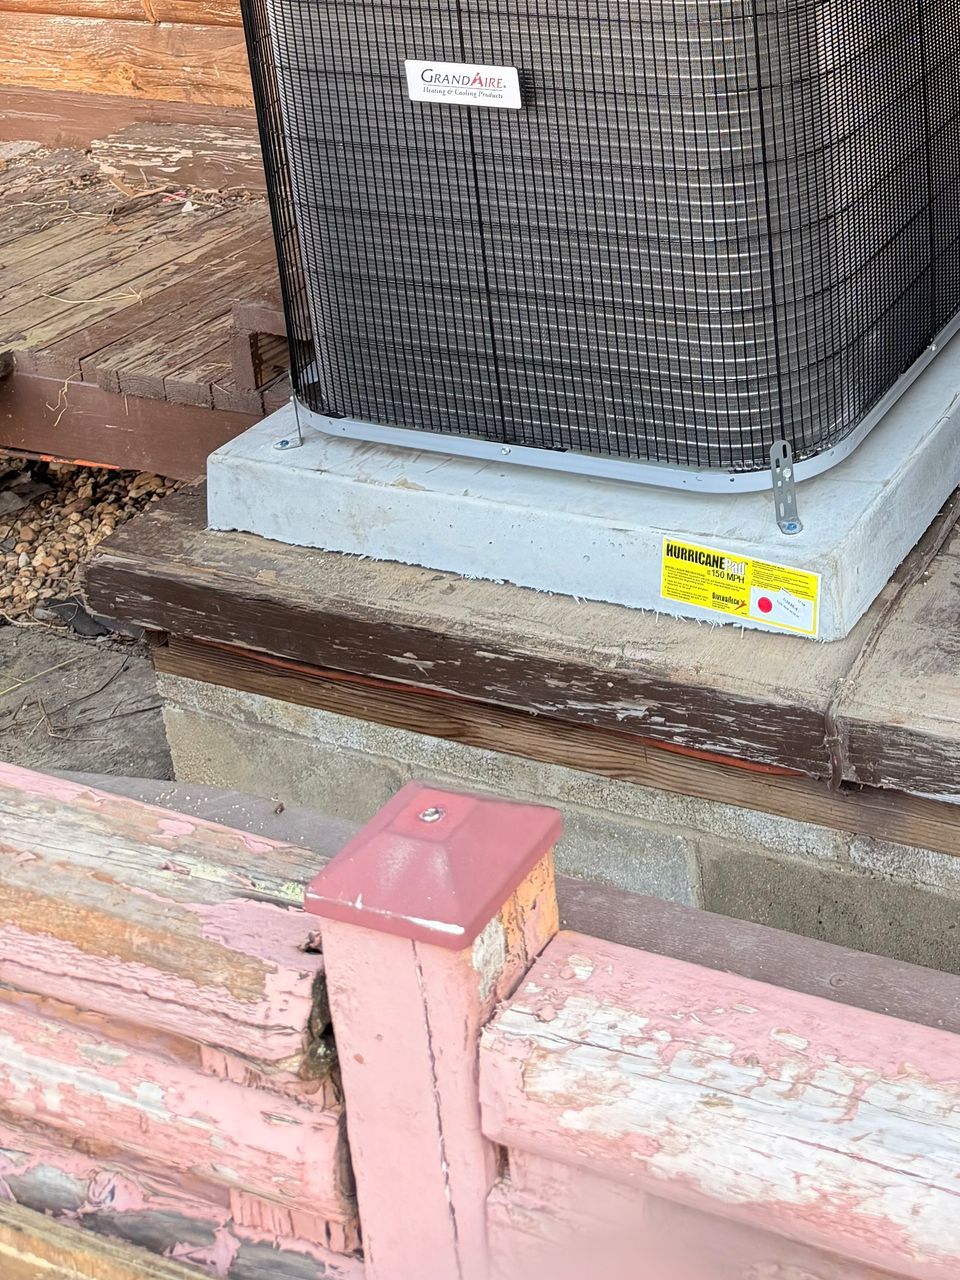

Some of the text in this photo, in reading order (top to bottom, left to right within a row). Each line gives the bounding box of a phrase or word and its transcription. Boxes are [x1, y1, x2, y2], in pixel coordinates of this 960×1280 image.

[423, 86, 446, 96] Heating
[454, 89, 477, 99] Cooling
[478, 91, 504, 100] Products
[726, 572, 745, 584] MPH
